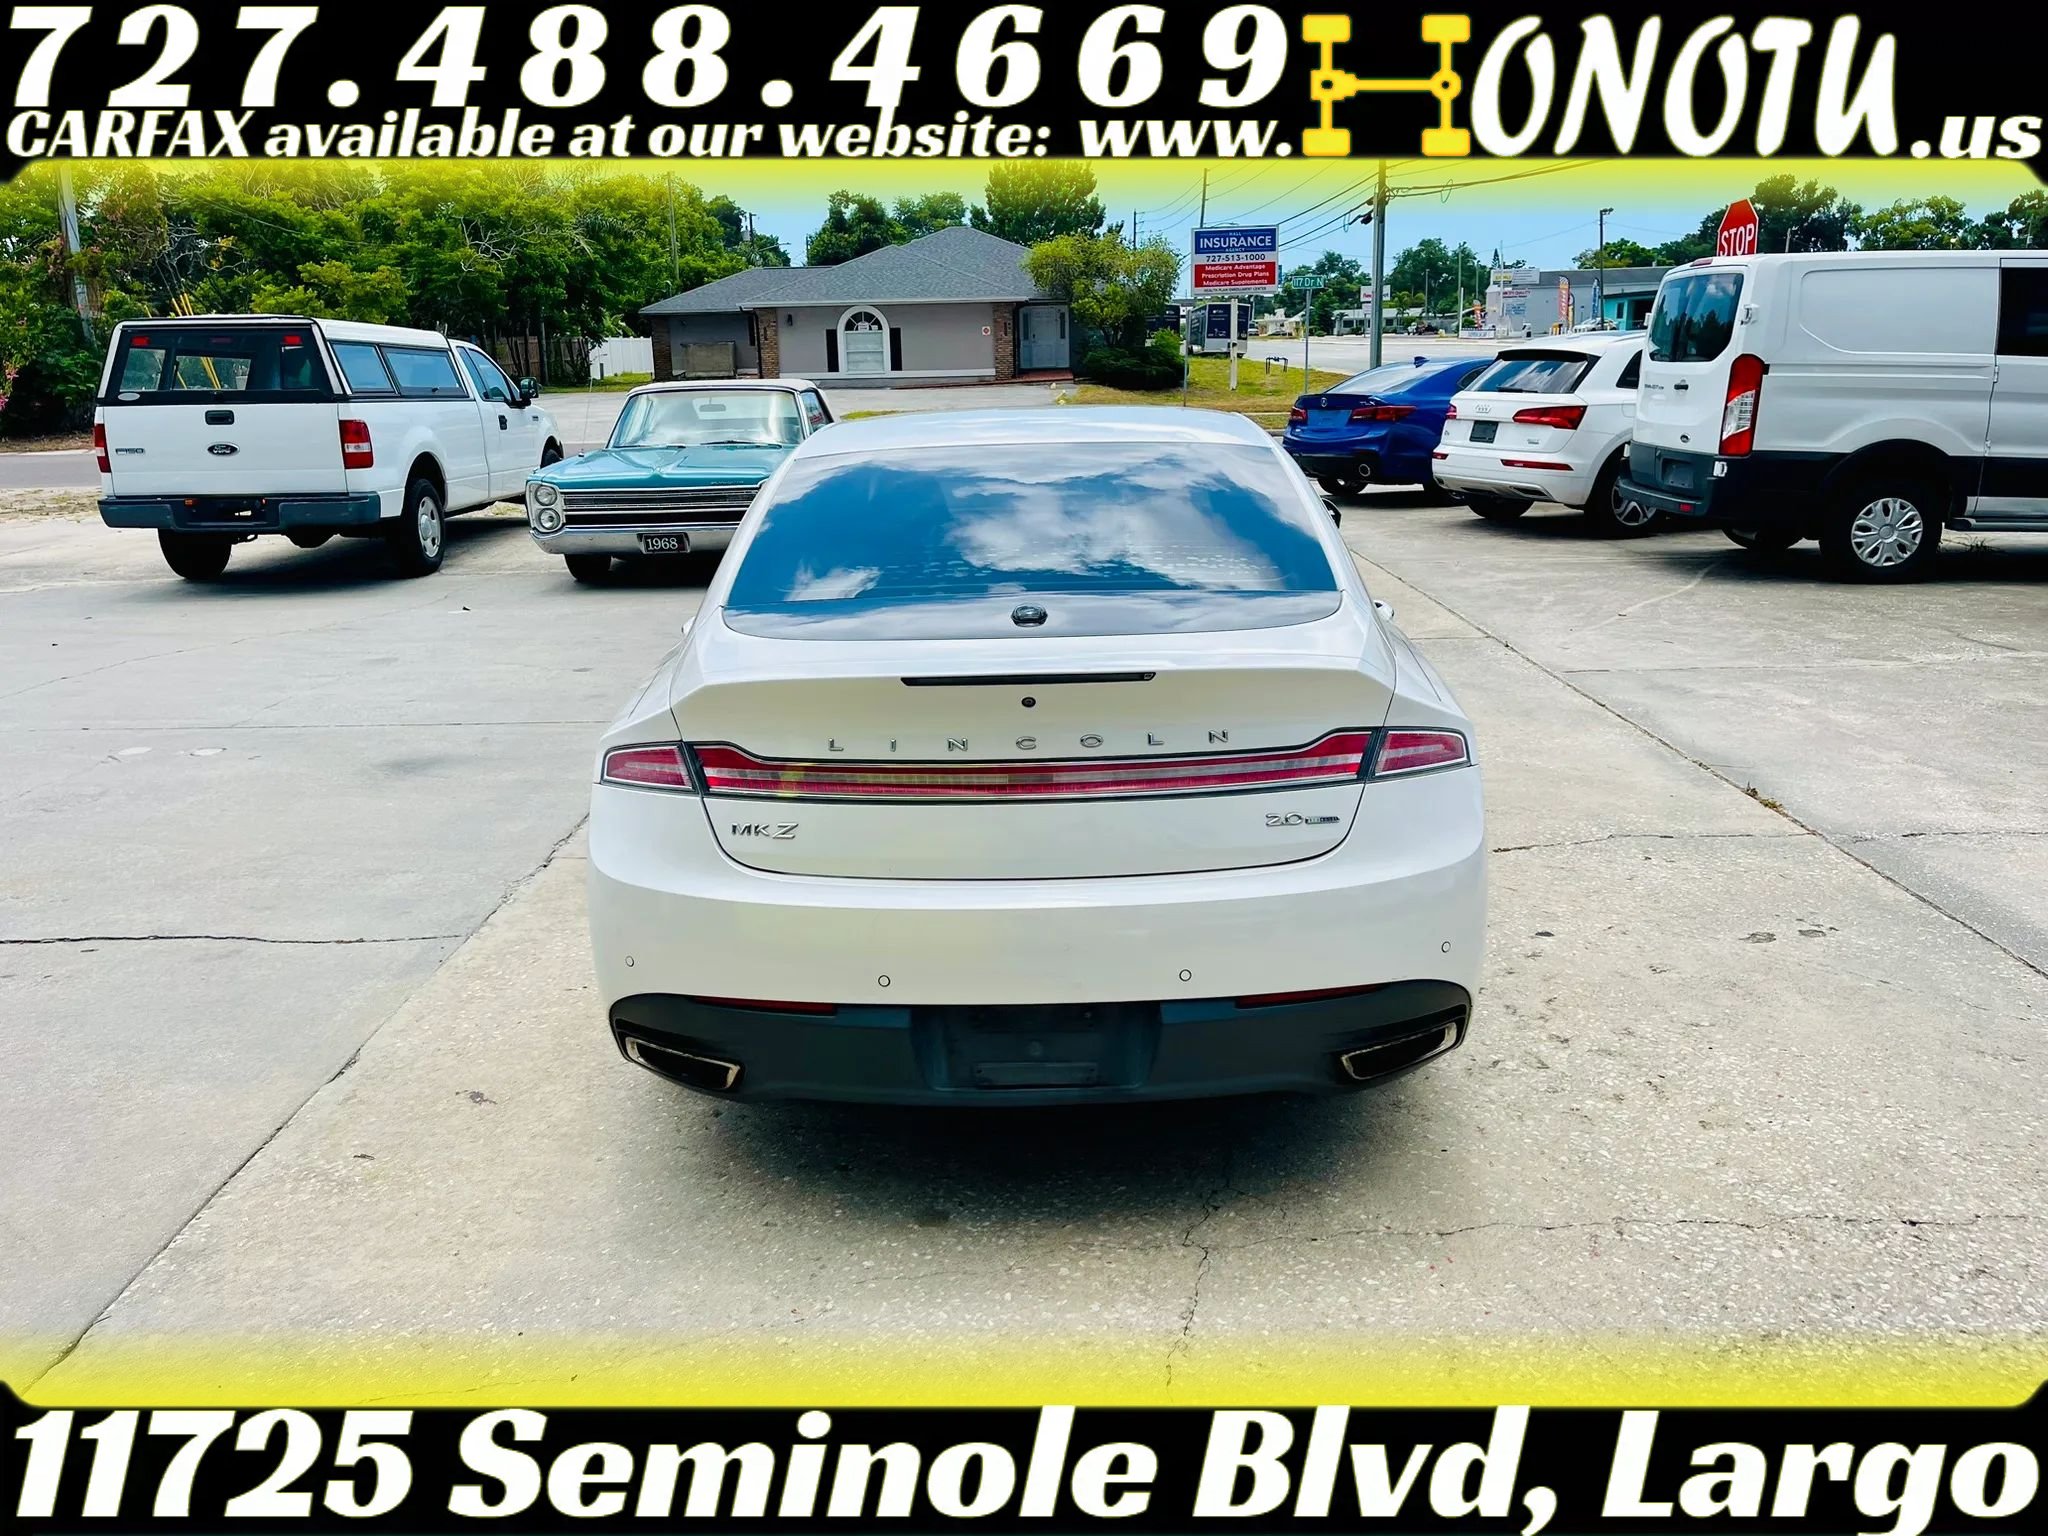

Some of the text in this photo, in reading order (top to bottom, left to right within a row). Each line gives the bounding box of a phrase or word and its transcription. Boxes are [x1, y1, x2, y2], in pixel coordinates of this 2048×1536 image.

[1200, 235, 1272, 249] INSURANCE
[1720, 223, 1755, 257] STOP
[1206, 253, 1266, 262] 727-513-1000
[1304, 277, 1314, 287] Dr
[646, 537, 679, 551] 1968
[828, 728, 1230, 753] LINCOLN
